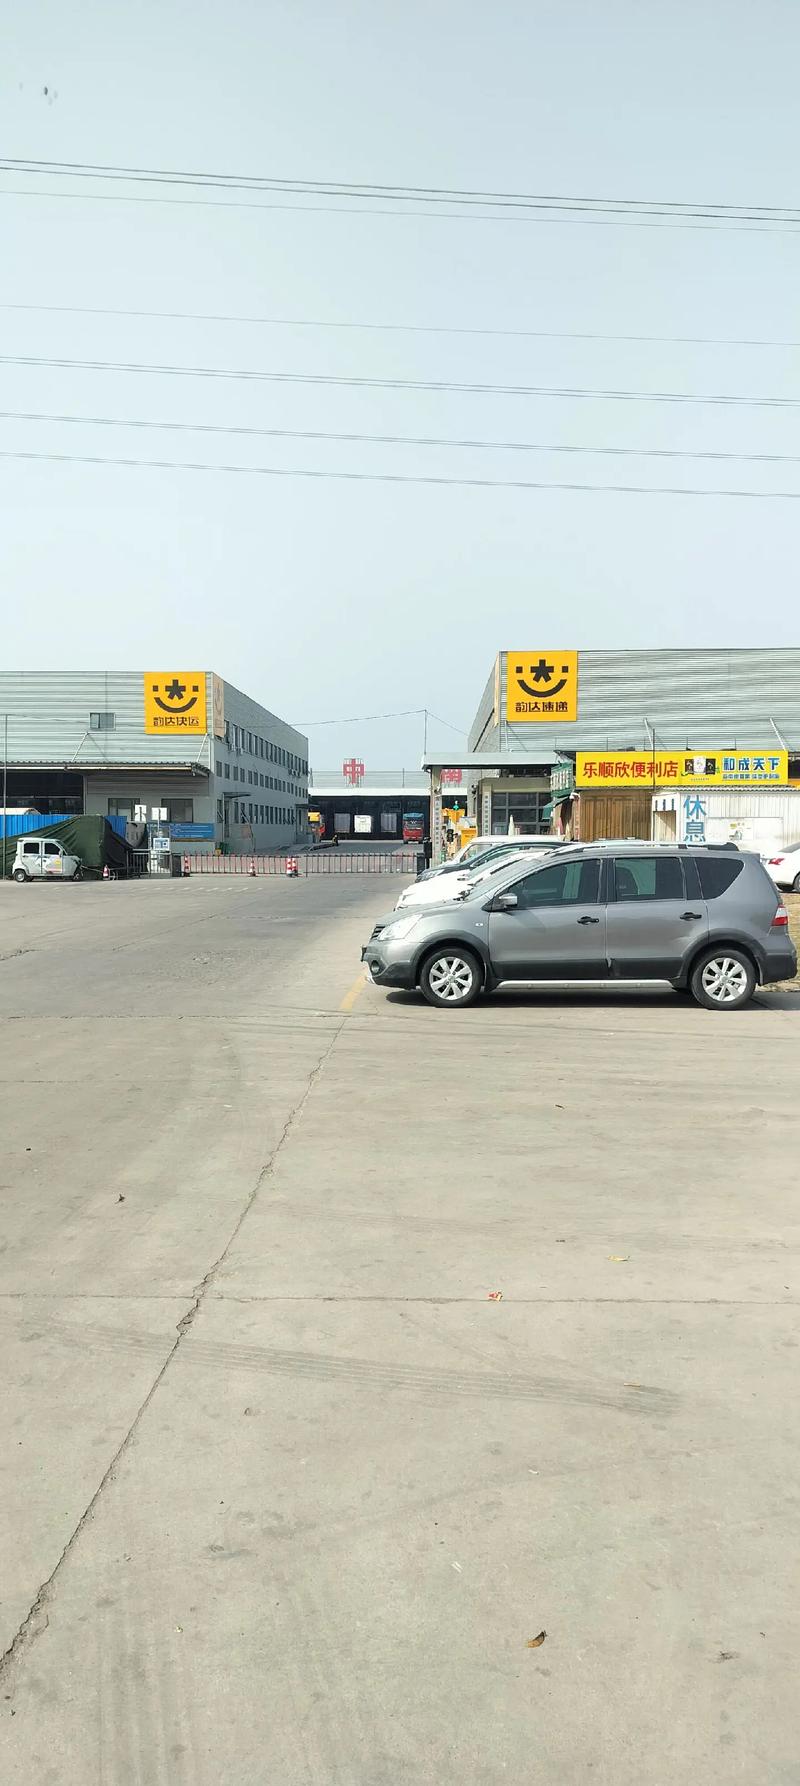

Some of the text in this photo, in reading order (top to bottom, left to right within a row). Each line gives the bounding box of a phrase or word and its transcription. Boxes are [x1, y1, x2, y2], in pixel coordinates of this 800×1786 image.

[515, 701, 568, 712] 韵达速递
[153, 716, 200, 727] 韵达快运
[582, 761, 678, 778] 乐顺欣便利店
[723, 757, 780, 770] 和成天下
[683, 795, 707, 842] 休息
